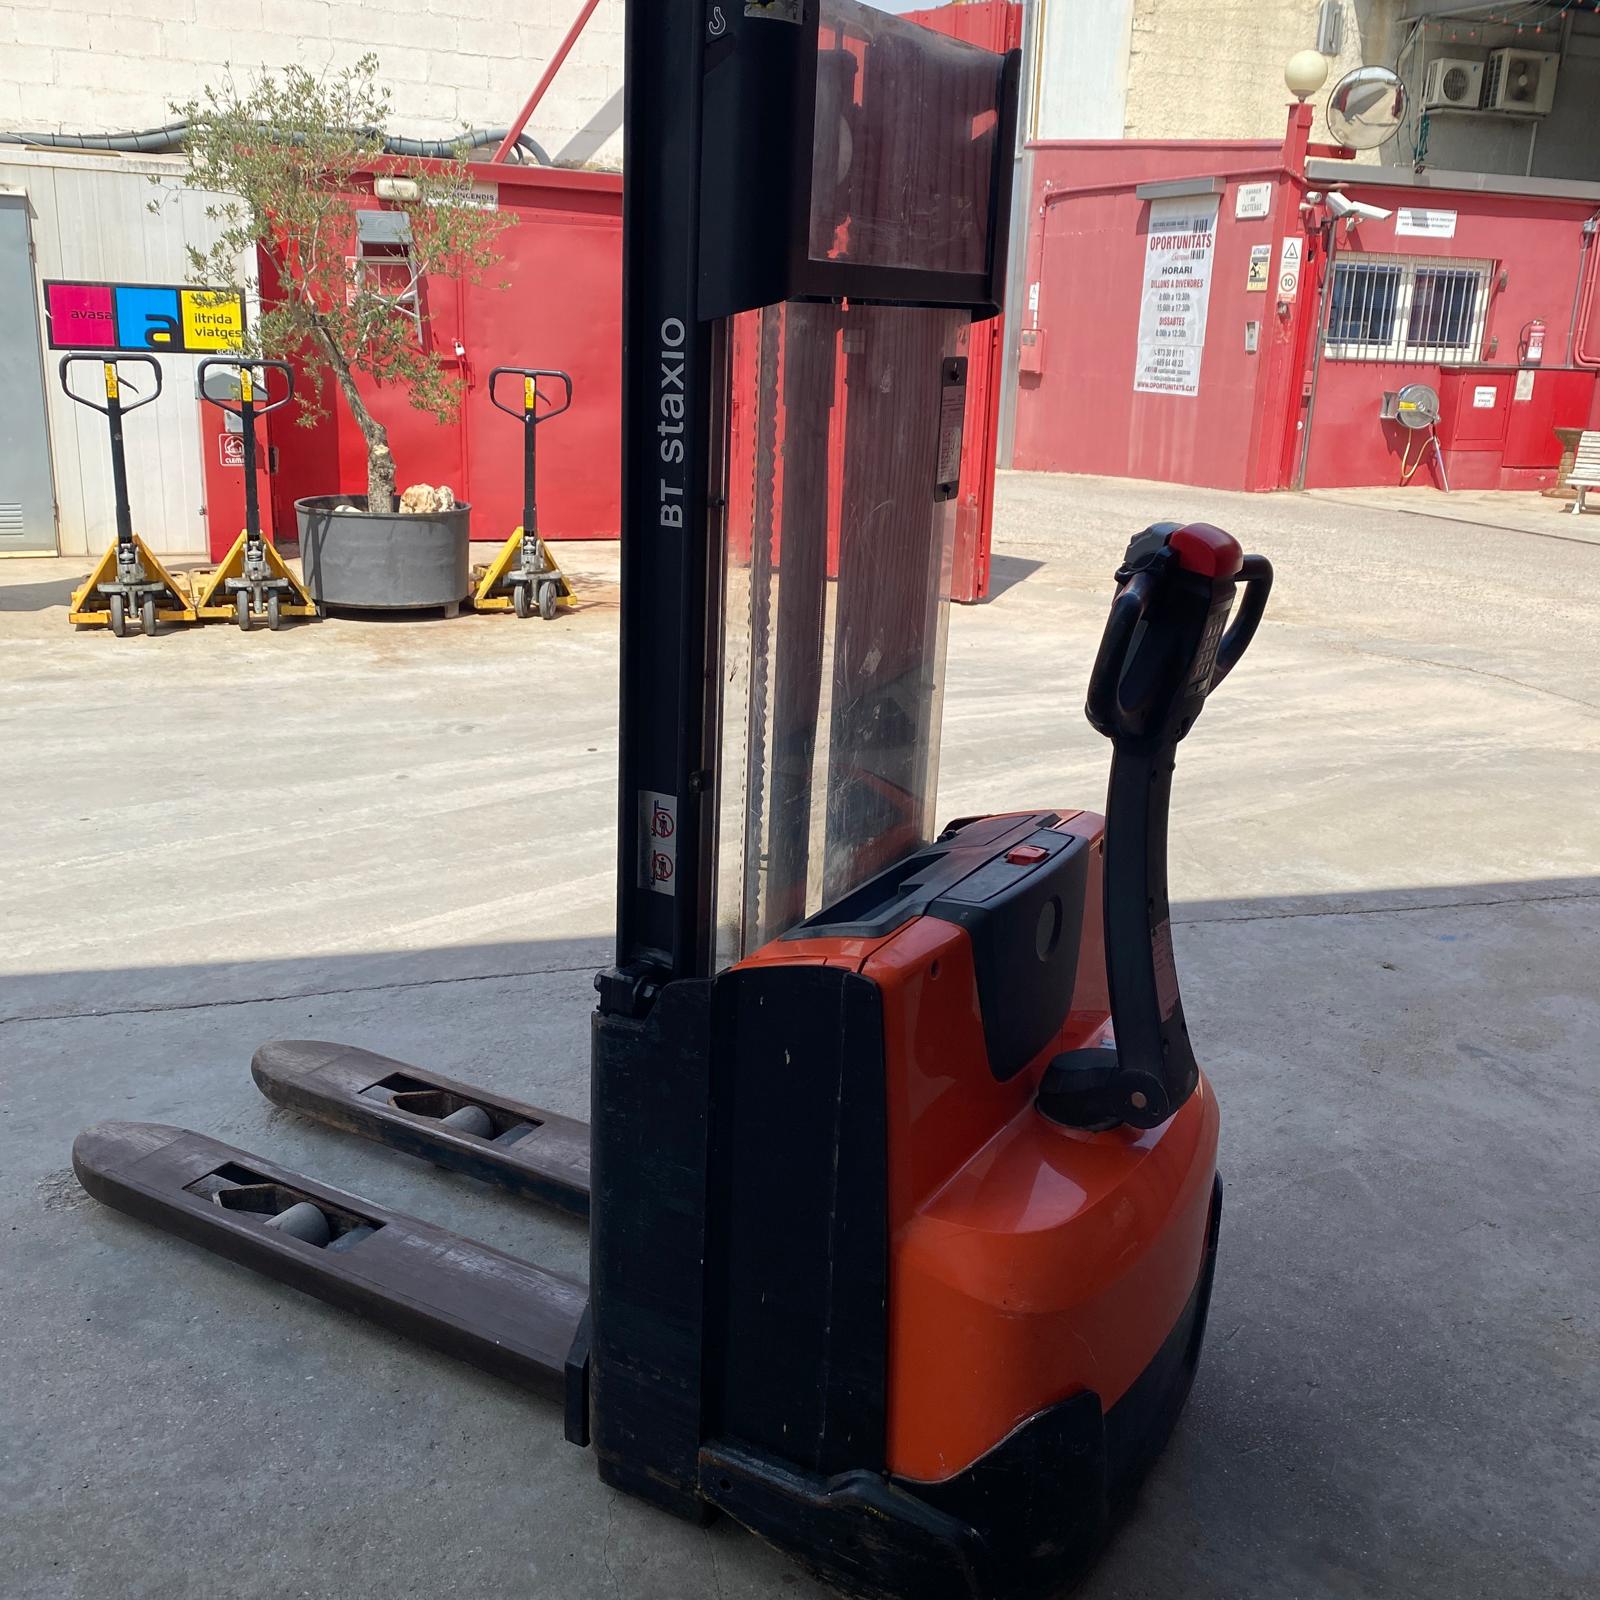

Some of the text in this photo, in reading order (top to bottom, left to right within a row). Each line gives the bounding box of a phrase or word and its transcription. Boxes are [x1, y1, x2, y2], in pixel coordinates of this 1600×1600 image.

[1150, 233, 1212, 251] OPORTUNITATS
[1162, 265, 1193, 275] HORARI
[1284, 278, 1293, 287] 10
[71, 310, 113, 320] avasa
[194, 313, 232, 324] iltrida
[194, 326, 242, 339] viatges
[660, 478, 683, 528] BT
